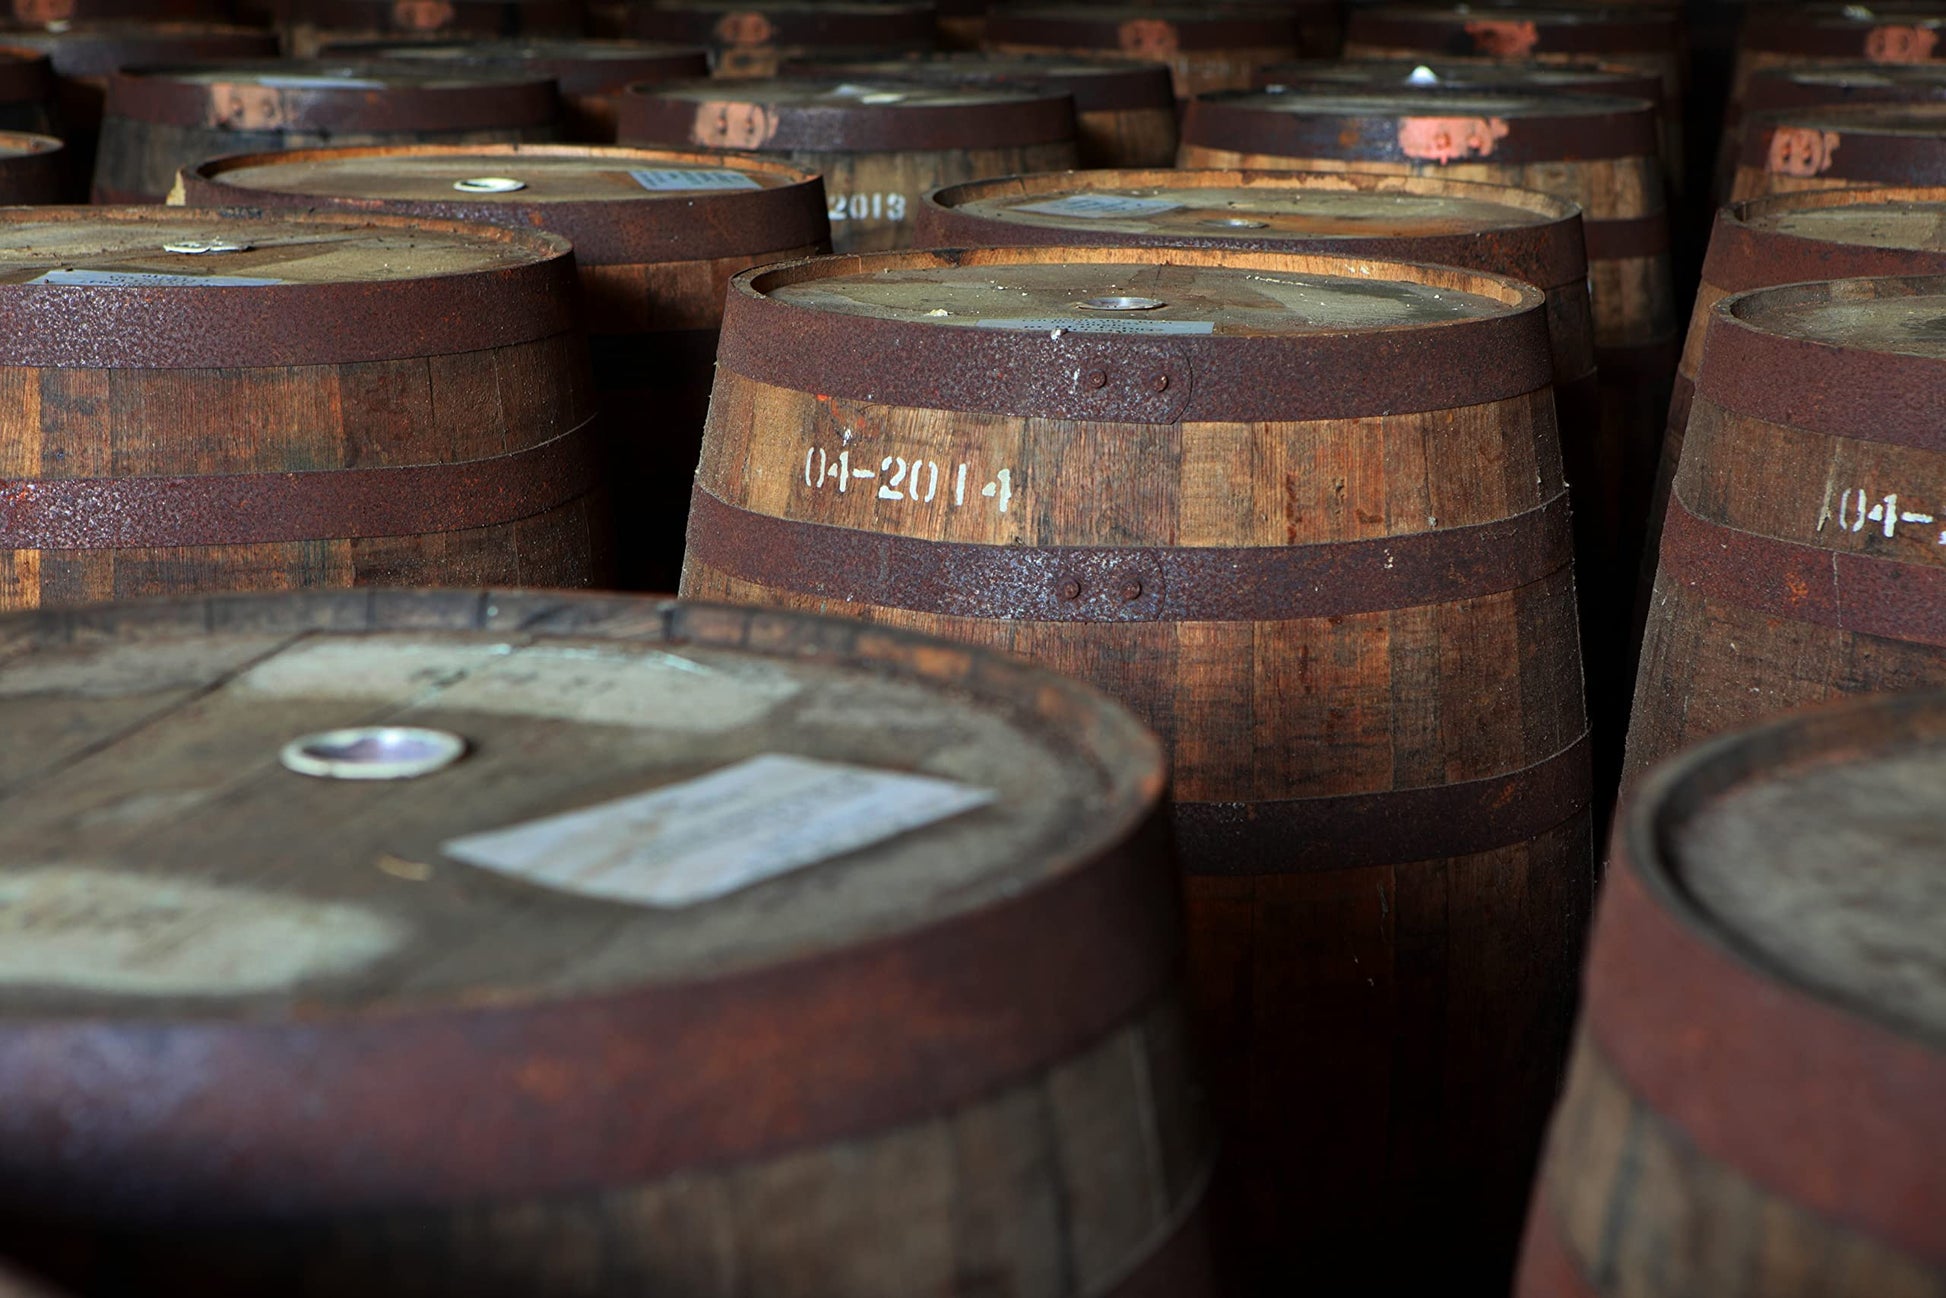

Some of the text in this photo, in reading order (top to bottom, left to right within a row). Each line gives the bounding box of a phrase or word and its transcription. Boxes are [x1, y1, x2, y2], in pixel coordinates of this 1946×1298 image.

[827, 192, 905, 221] 2013
[805, 447, 1012, 512] 04-2014
[1839, 488, 1946, 545] 04-
